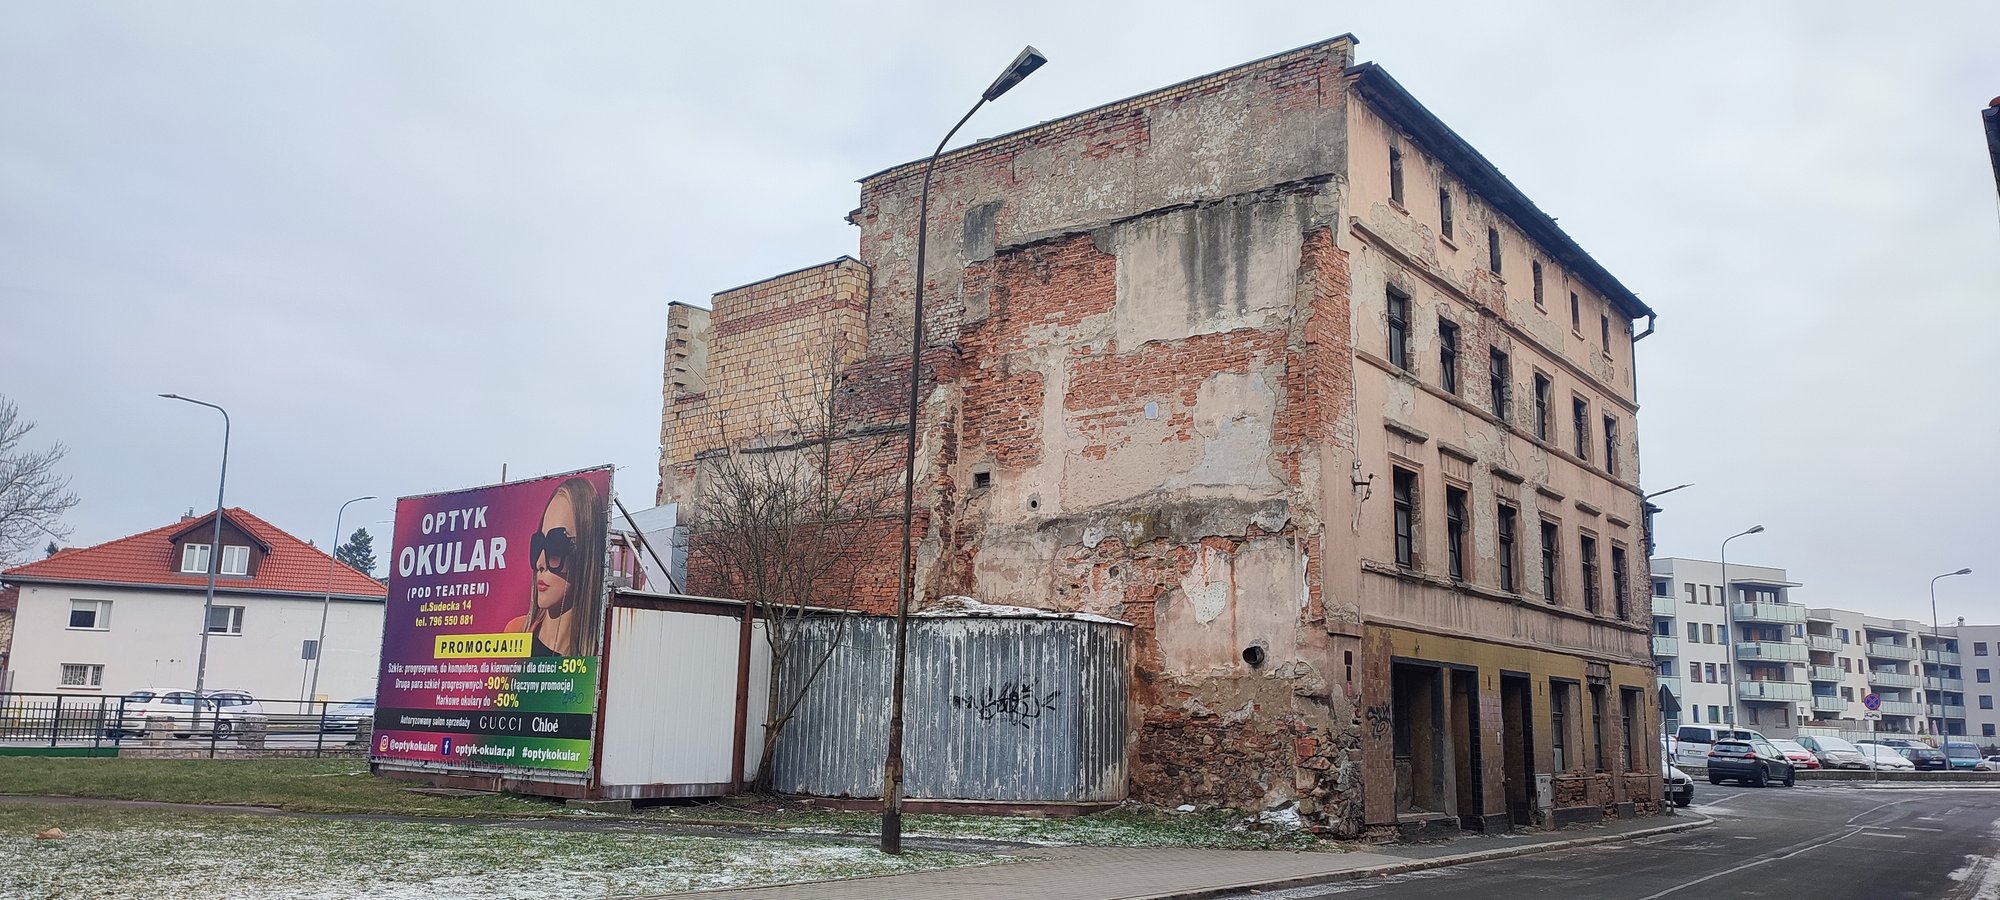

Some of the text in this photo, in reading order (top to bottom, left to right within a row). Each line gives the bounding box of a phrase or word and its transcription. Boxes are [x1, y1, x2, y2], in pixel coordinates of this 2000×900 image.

[422, 505, 489, 535] OPTYK
[399, 537, 507, 578] OKULAR
[407, 582, 490, 602] (POD TEATREM)
[420, 600, 472, 613] ul.Sudecka 14
[415, 614, 474, 627] tel. 796 550 881
[441, 640, 523, 654] PROMOCJA!!!
[388, 663, 404, 673] Szkła:
[404, 663, 439, 675] progresywne,
[440, 663, 447, 673] do
[448, 662, 479, 675] komputera,
[480, 662, 489, 673] dla
[490, 662, 522, 673] kierowców
[526, 662, 537, 673] dla
[537, 662, 557, 673] dzieci
[558, 658, 587, 674] -50%
[396, 676, 574, 694] Druga para szkieł progresywnych -90% (łączymy promocje)
[436, 693, 519, 709] Markowe okulary do -50%
[400, 715, 471, 730] Autoryzowany salon sprzedaży
[479, 715, 522, 731] GUCCI
[532, 716, 559, 733] Chloé
[390, 739, 438, 753] @optykokular
[455, 744, 516, 760] optyk-okular.pl
[522, 746, 581, 762] #optykokular
